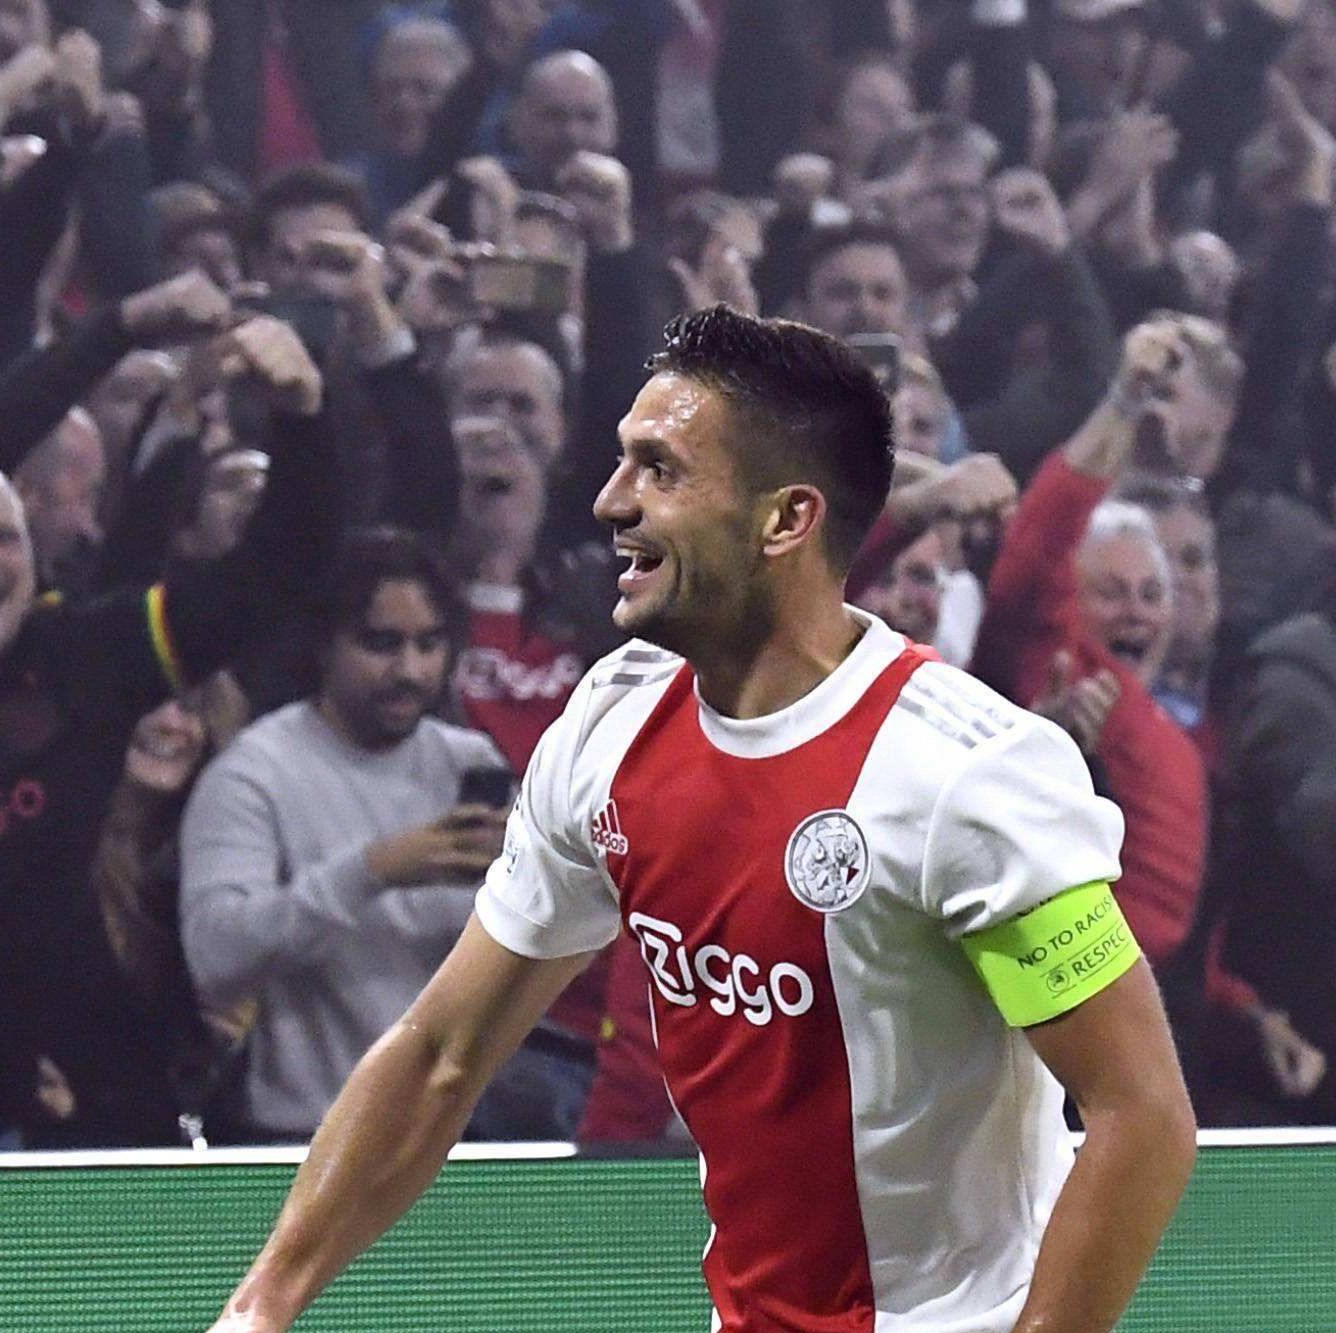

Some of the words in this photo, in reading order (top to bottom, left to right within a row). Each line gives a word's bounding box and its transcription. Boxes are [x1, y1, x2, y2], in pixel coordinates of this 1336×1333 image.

[629, 911, 814, 1026] Ziggo
[1017, 946, 1048, 970] NO
[1049, 930, 1073, 950] TO
[1075, 894, 1114, 935] RACIS
[1071, 923, 1125, 976] RESPEC
